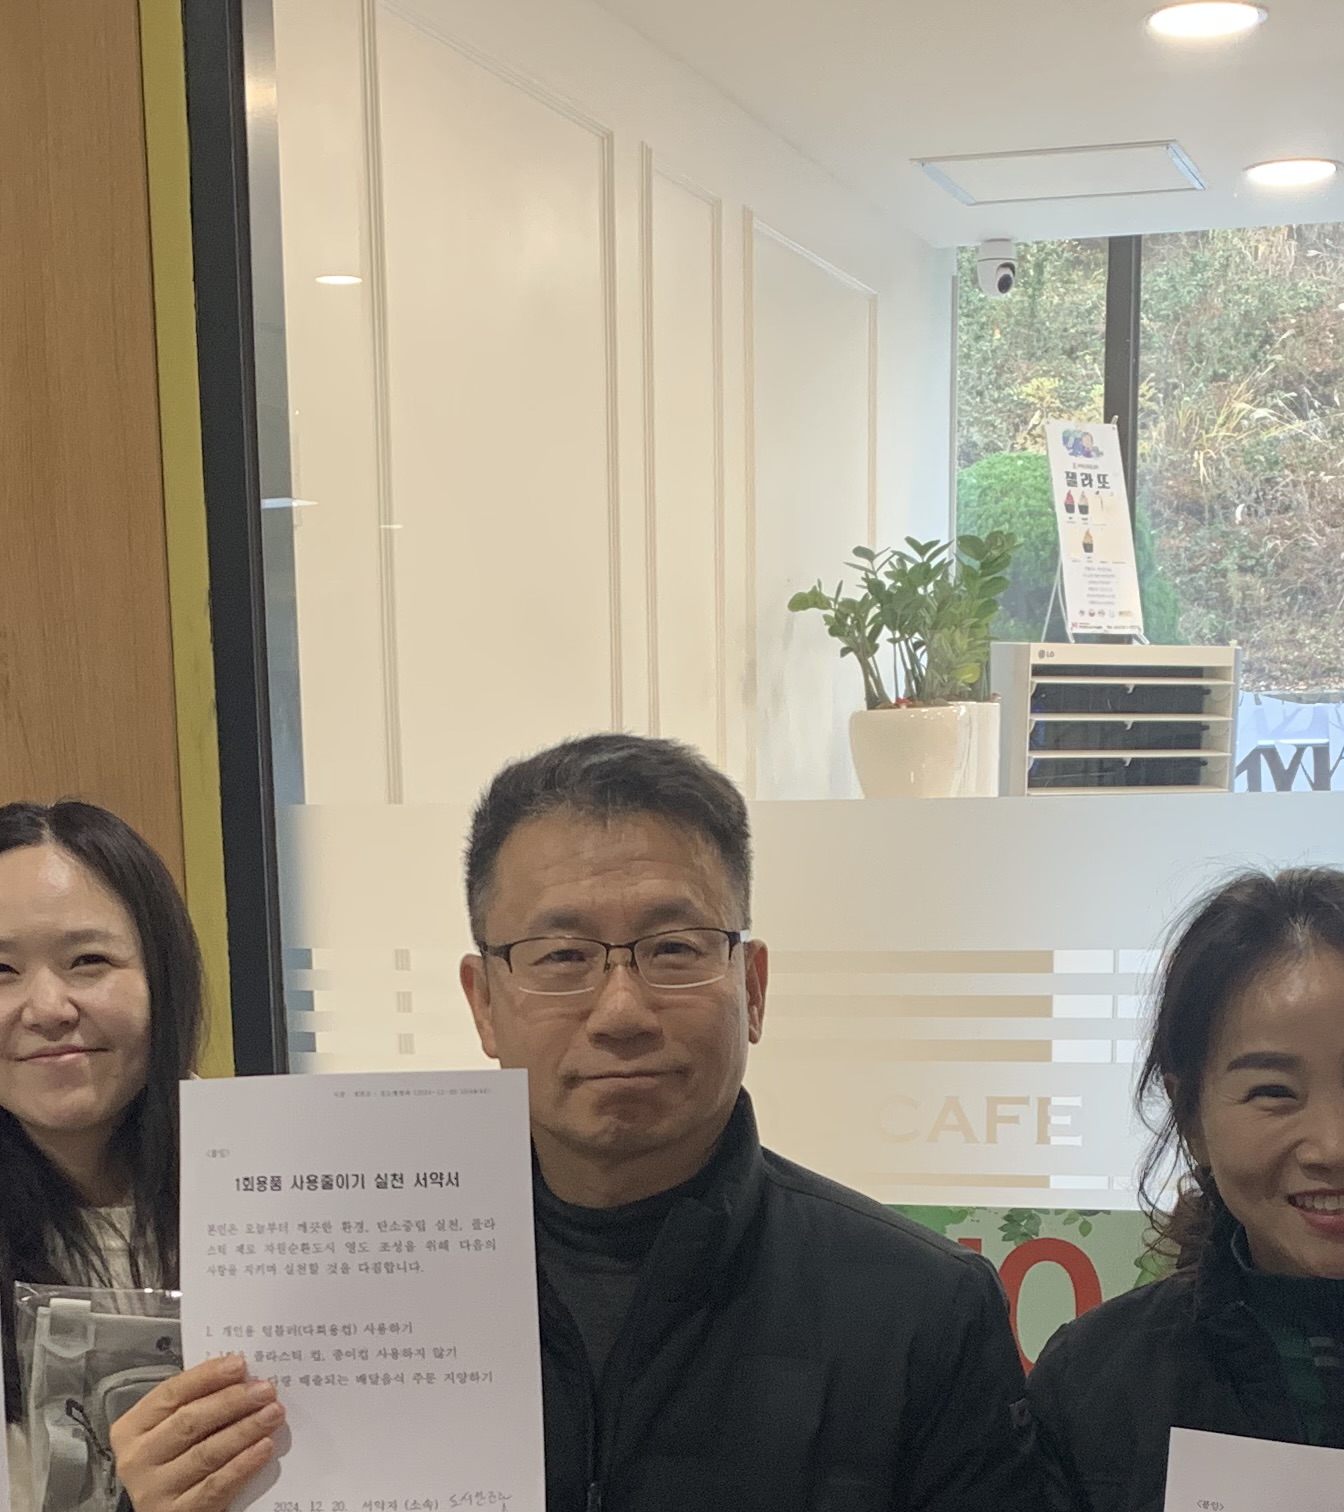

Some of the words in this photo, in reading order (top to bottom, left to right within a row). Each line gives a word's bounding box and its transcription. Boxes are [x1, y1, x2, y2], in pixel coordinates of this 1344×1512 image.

[879, 1094, 1083, 1147] CAFE
[236, 1176, 281, 1192] 1회용품
[291, 1174, 365, 1191] 사용줄이기
[375, 1173, 404, 1189] 실천
[414, 1172, 459, 1188] 서약서
